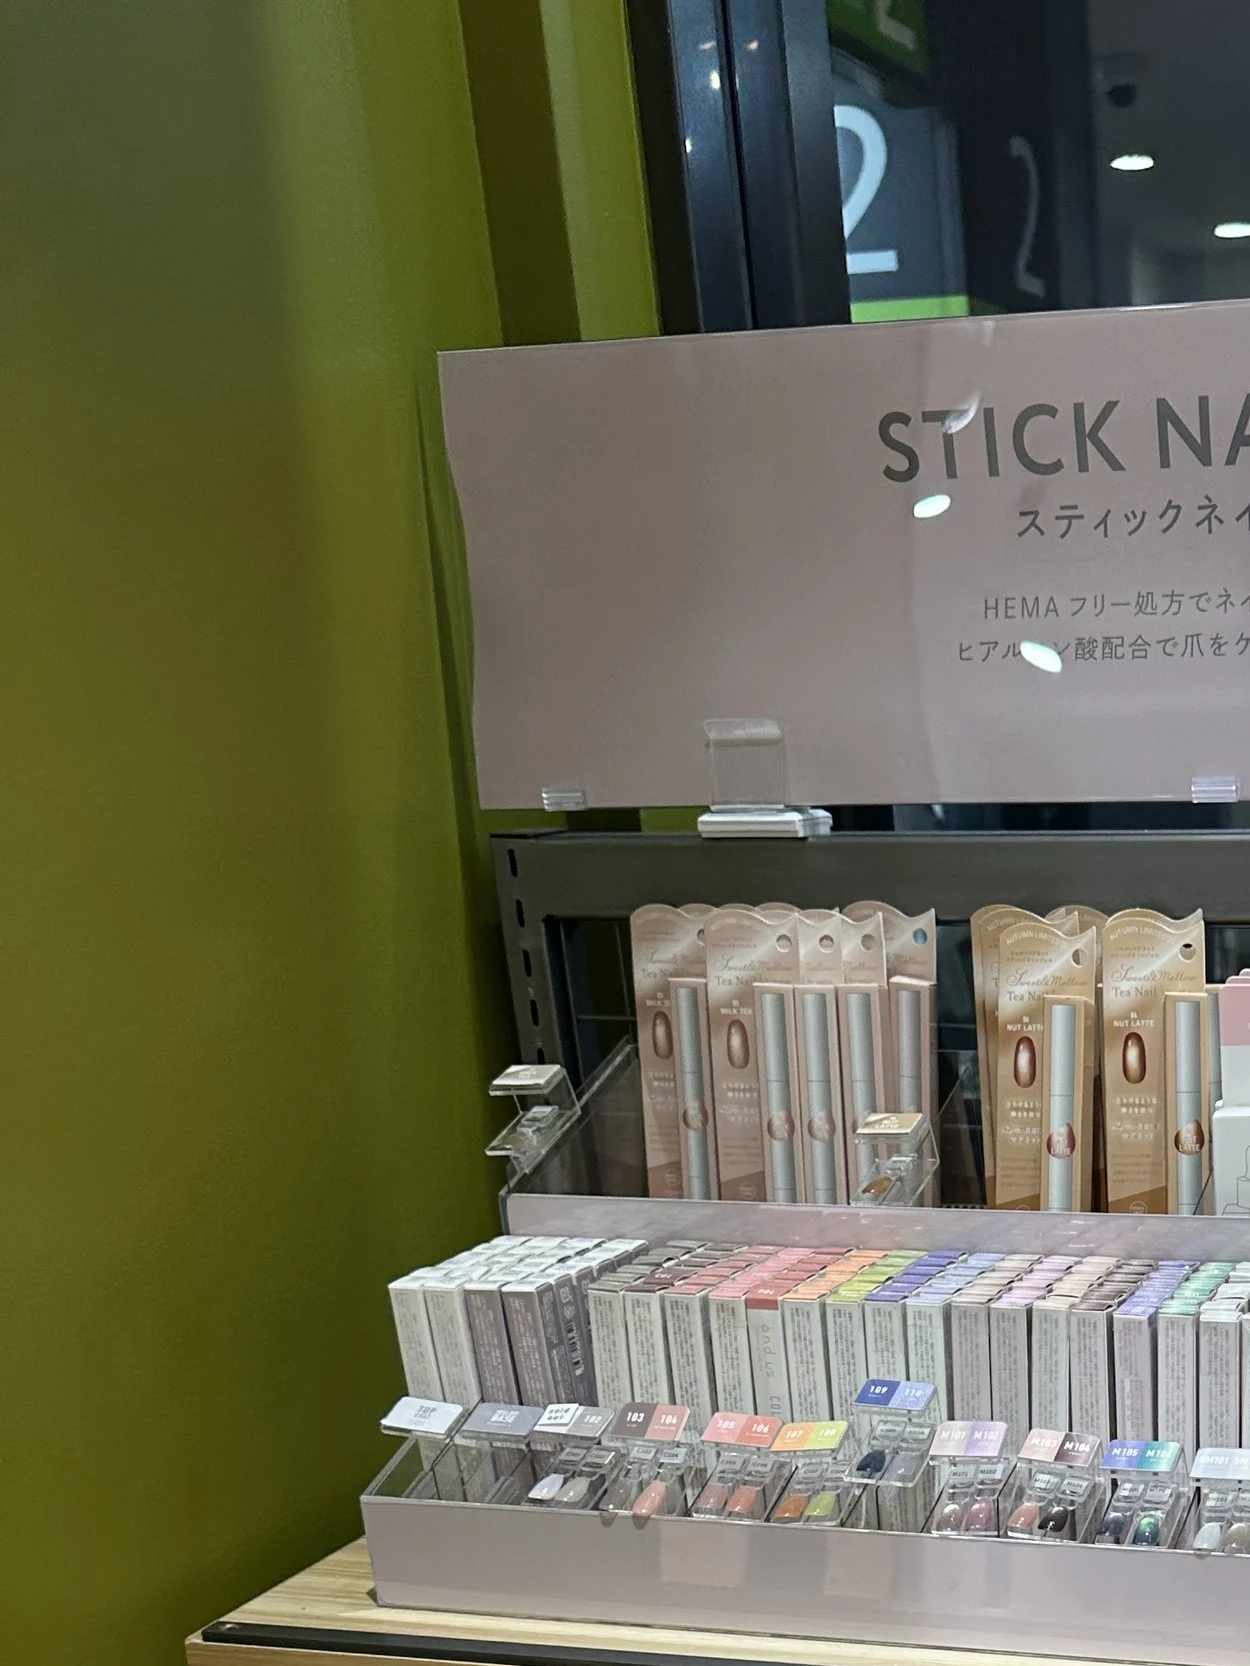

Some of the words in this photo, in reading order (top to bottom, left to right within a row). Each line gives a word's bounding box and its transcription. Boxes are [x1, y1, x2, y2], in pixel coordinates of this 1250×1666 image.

[877, 398, 1127, 484] STICK
[983, 595, 1060, 620] HEMA
[1006, 990, 1025, 1002] Tea
[1113, 986, 1132, 998] Tea
[869, 1385, 888, 1396] 109
[626, 1412, 645, 1423] 103
[751, 1423, 770, 1434] 106
[940, 1430, 967, 1441] M101
[973, 1430, 1000, 1441] M102
[1063, 1440, 1092, 1453] M104
[1111, 1446, 1139, 1458] M105
